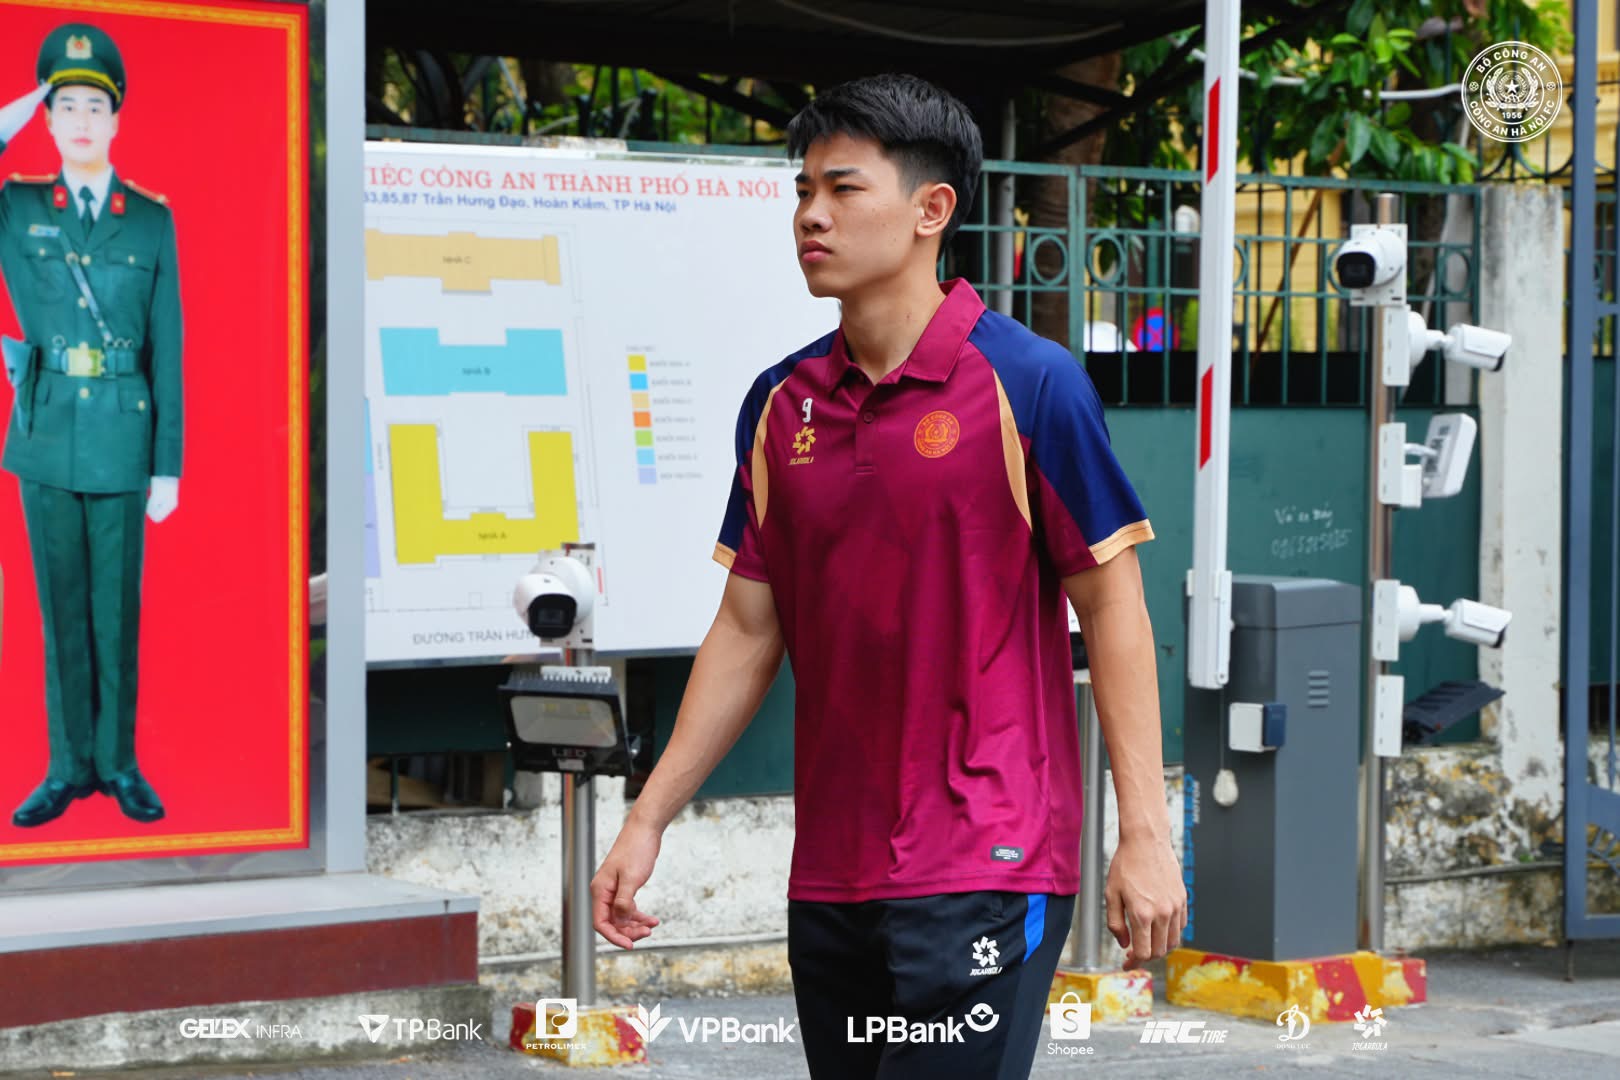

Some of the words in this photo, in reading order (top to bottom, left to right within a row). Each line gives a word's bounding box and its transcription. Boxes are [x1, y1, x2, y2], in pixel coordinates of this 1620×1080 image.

[366, 163, 413, 189] IỆC
[420, 165, 492, 188] CÔNG
[501, 171, 535, 190] AN
[543, 169, 632, 193] THÀNH
[640, 170, 689, 196] PHỐ
[737, 177, 780, 201] NỘI
[802, 397, 813, 424] 9
